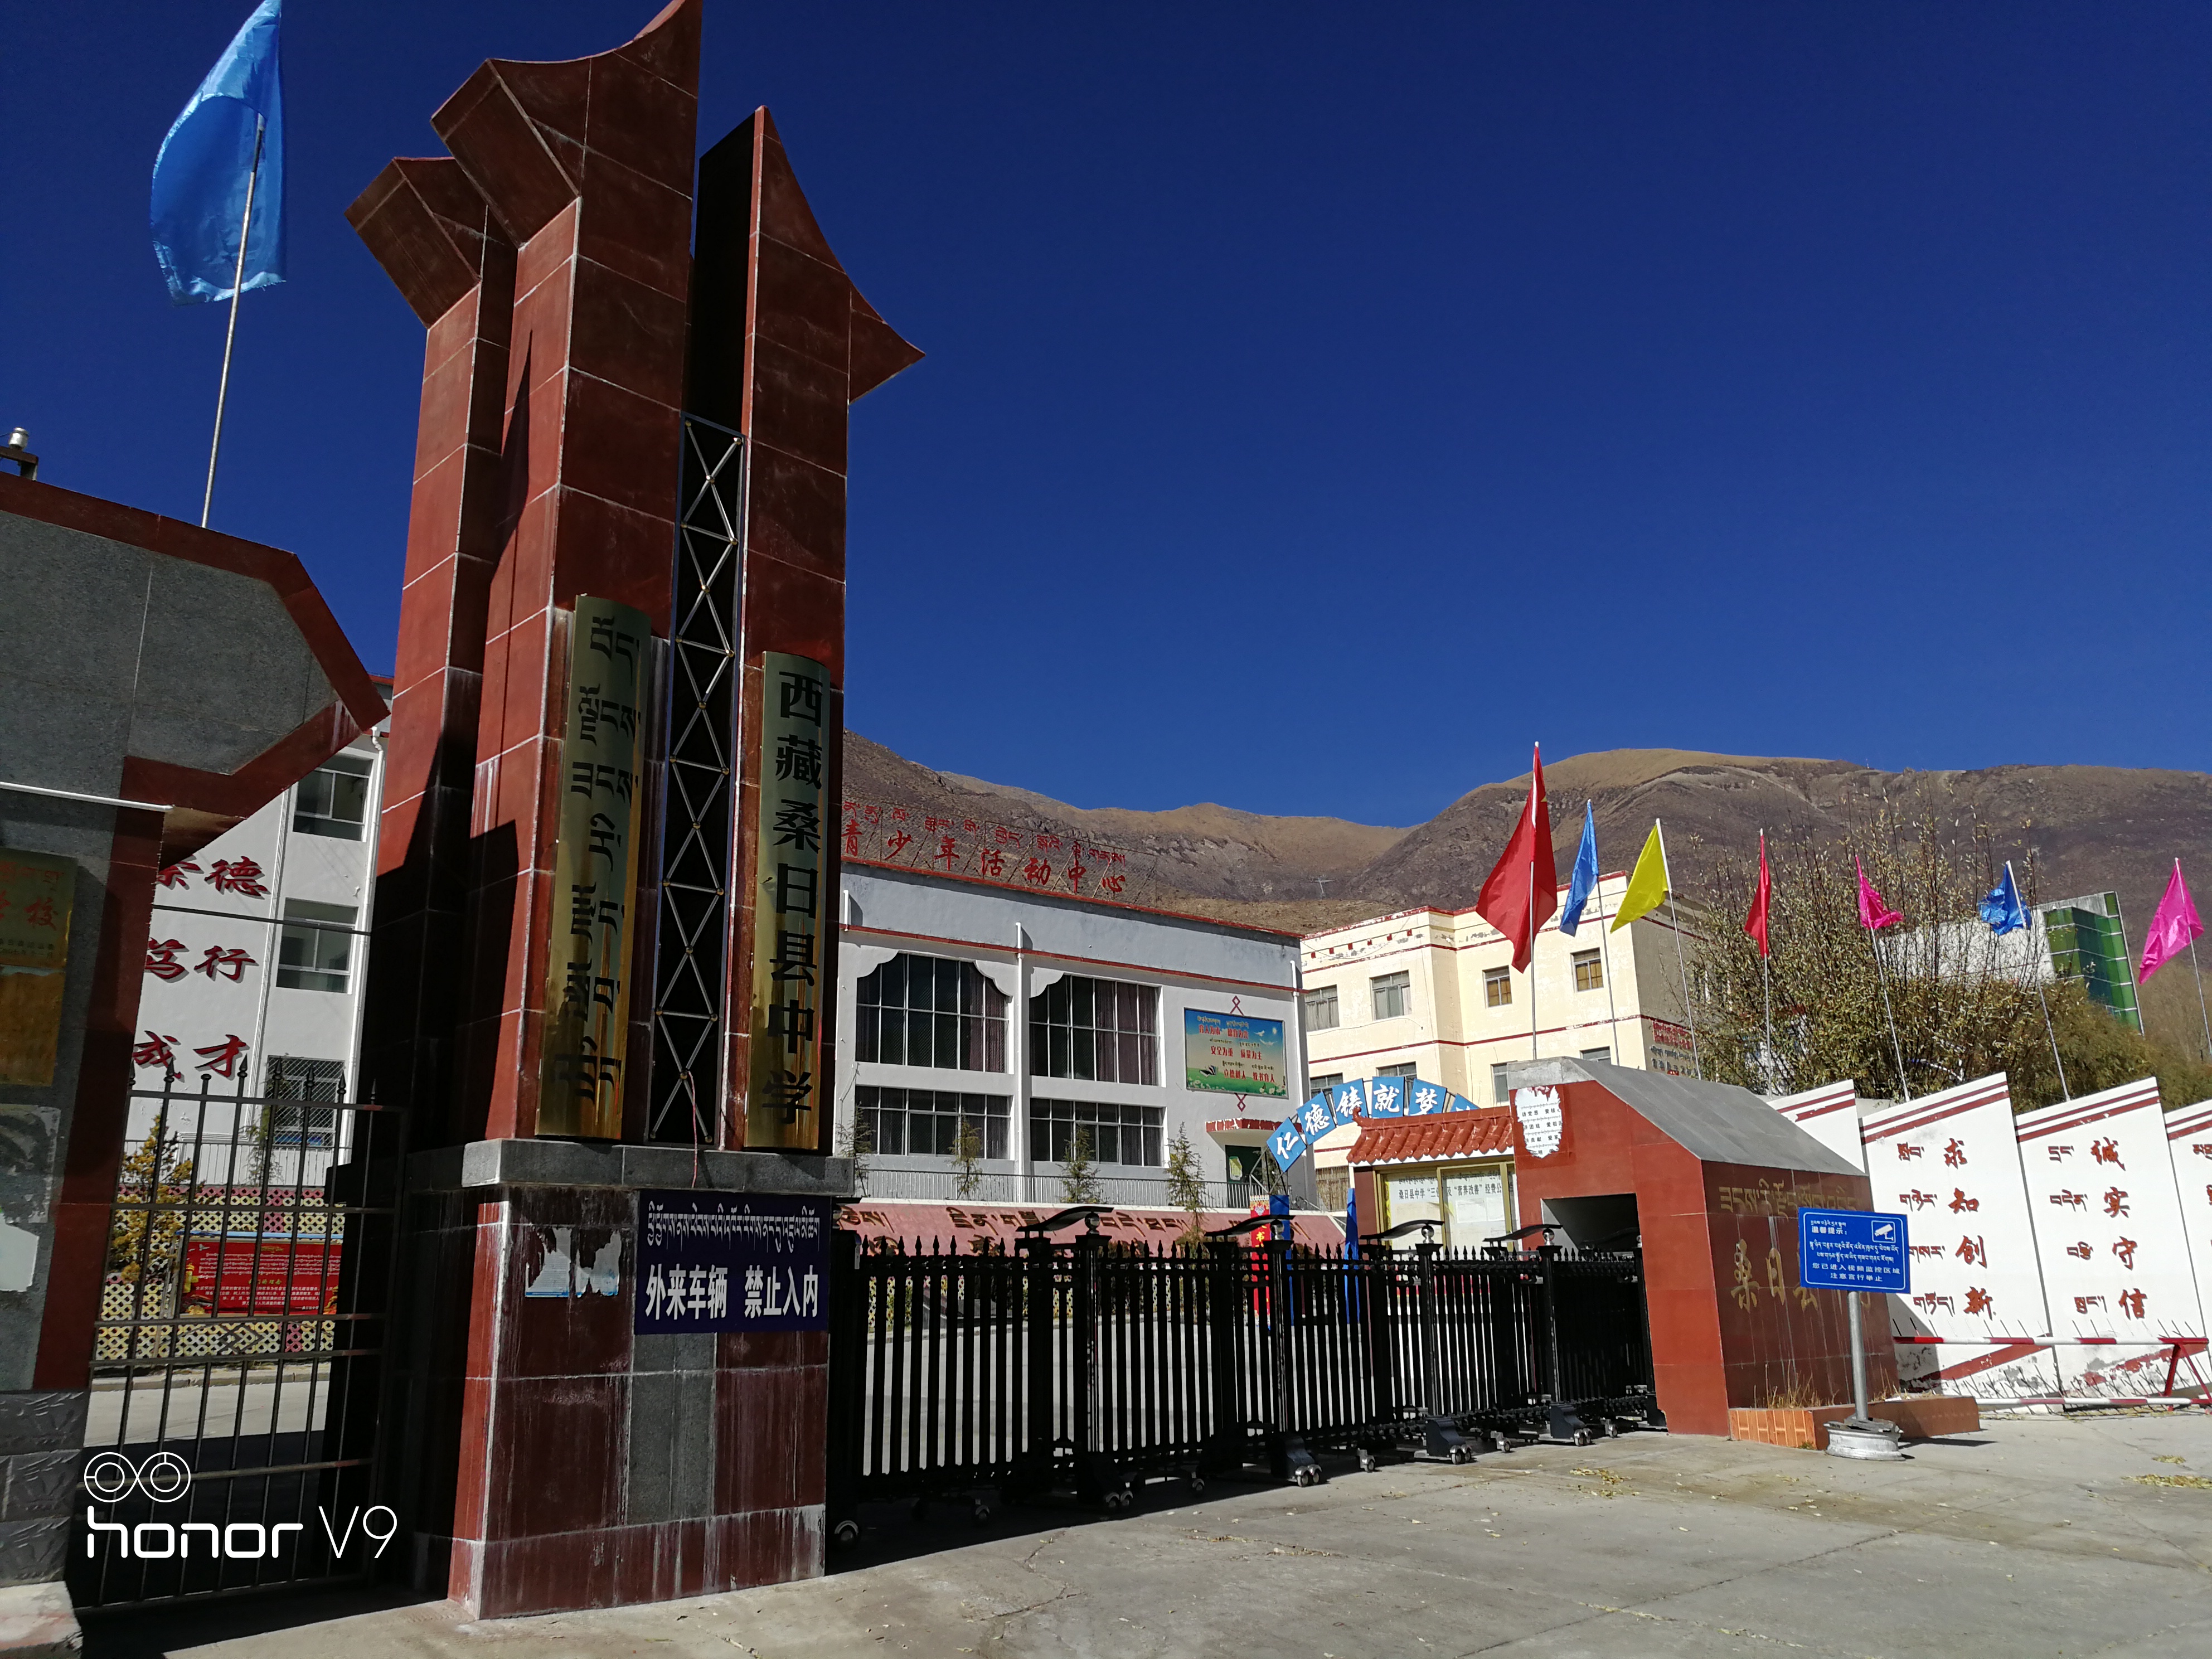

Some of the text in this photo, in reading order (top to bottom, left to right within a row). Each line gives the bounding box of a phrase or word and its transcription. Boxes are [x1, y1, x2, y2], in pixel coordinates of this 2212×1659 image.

[841, 819, 1126, 893] 青少年活动中心
[762, 671, 823, 1125] 西藏桑日县中学
[133, 1030, 246, 1079] 成才
[1211, 1045, 1233, 1057] 安全为重
[1943, 1138, 1993, 1321] 求知创新
[2090, 1137, 2148, 1320] 诚实守信
[646, 1264, 818, 1320] 外来车辆 禁止入内
[1812, 1262, 1900, 1274] 您已进入视频监控区域
[1830, 1272, 1883, 1282] 注意言行举止
